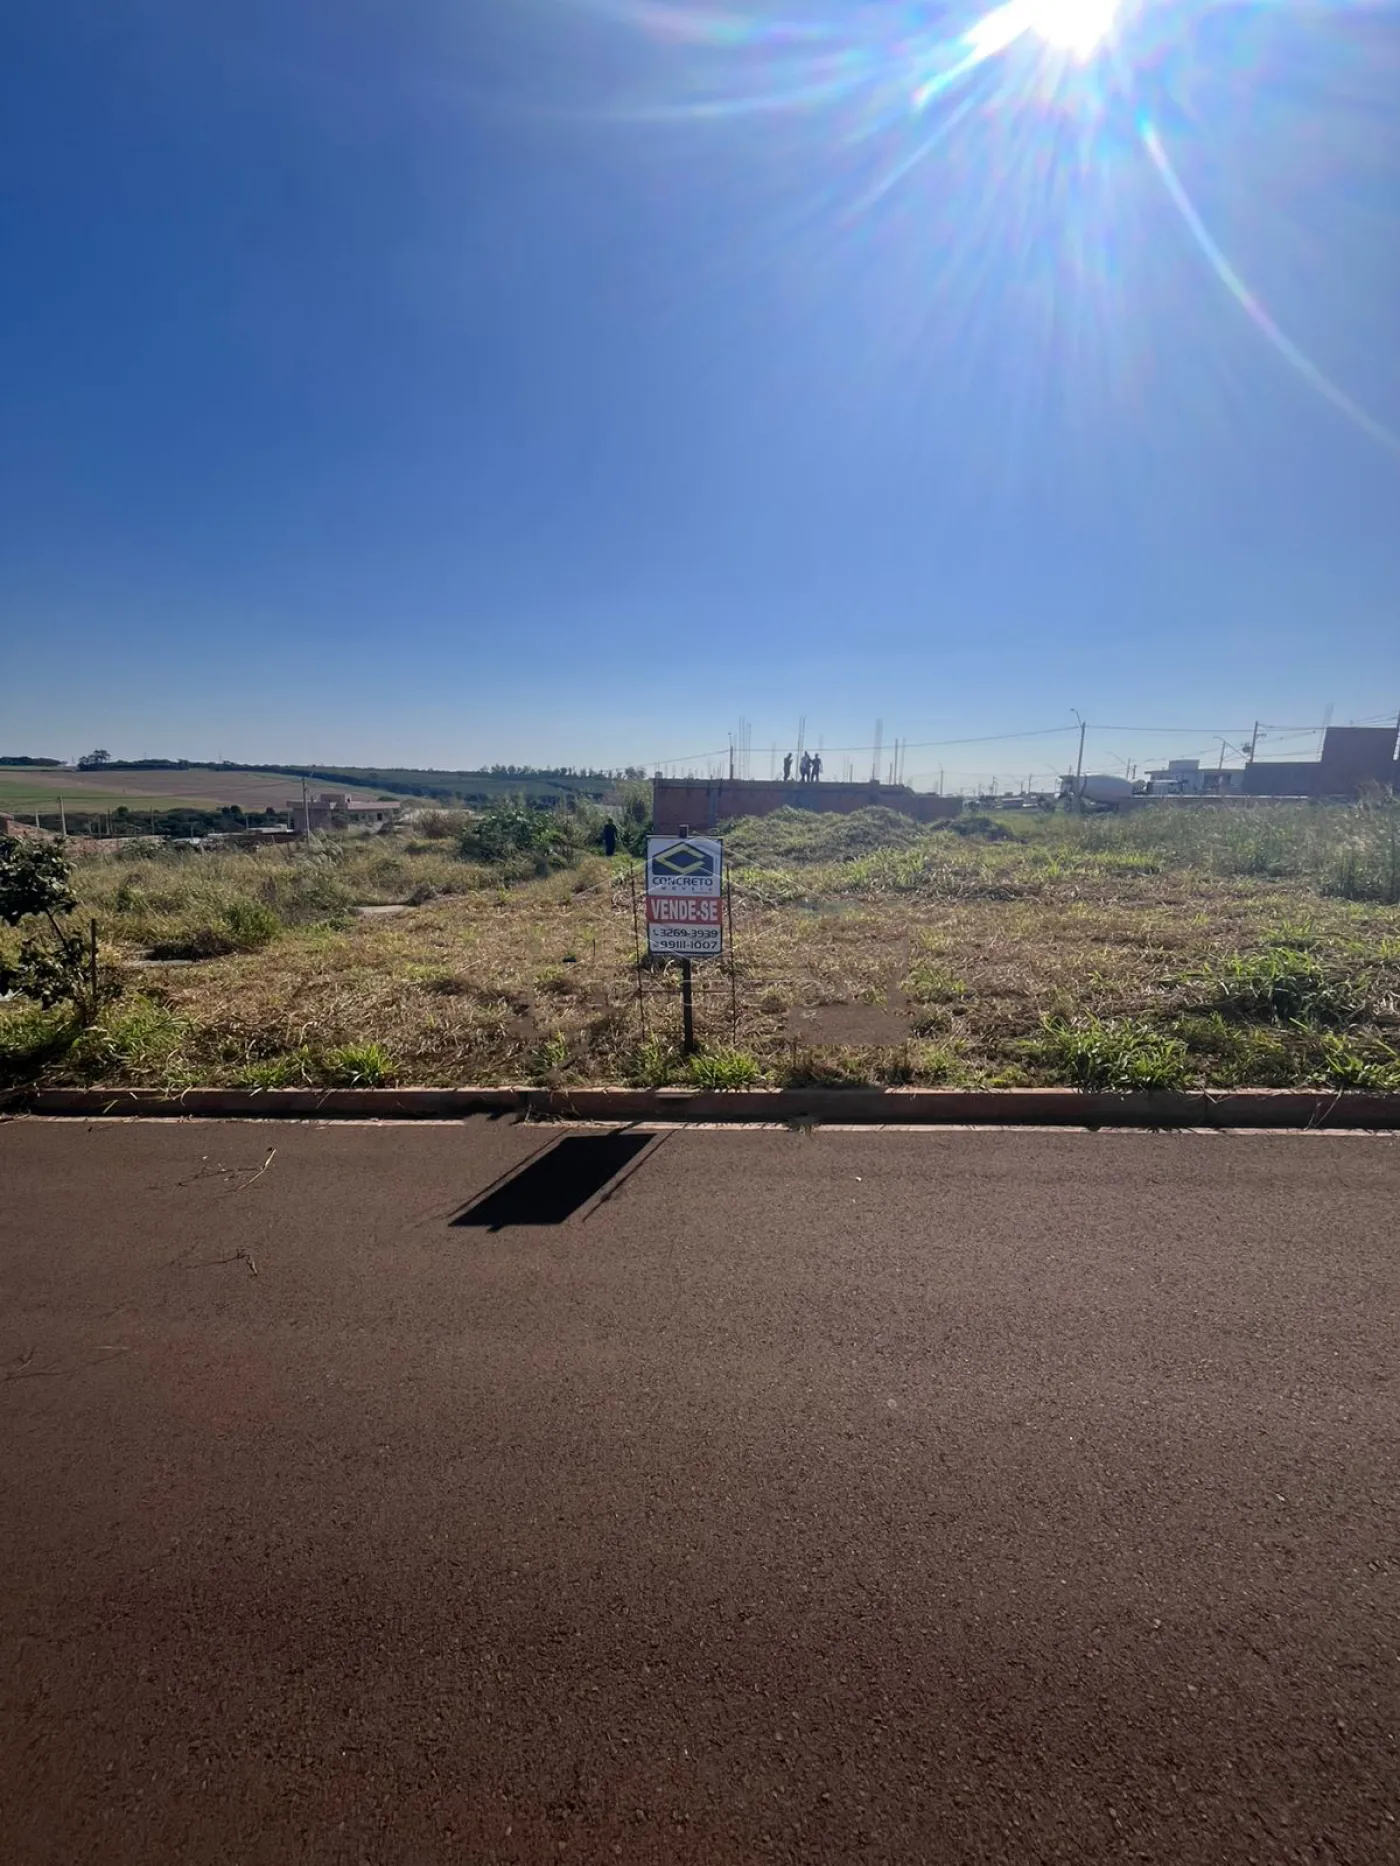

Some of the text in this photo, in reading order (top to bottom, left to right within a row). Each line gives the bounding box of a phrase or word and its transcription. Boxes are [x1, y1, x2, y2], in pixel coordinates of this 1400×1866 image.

[652, 876, 713, 886] CONCRETO
[650, 899, 718, 921] VENDE-SE
[660, 929, 719, 938] 3269-3939
[660, 940, 718, 949] 99111-1007
